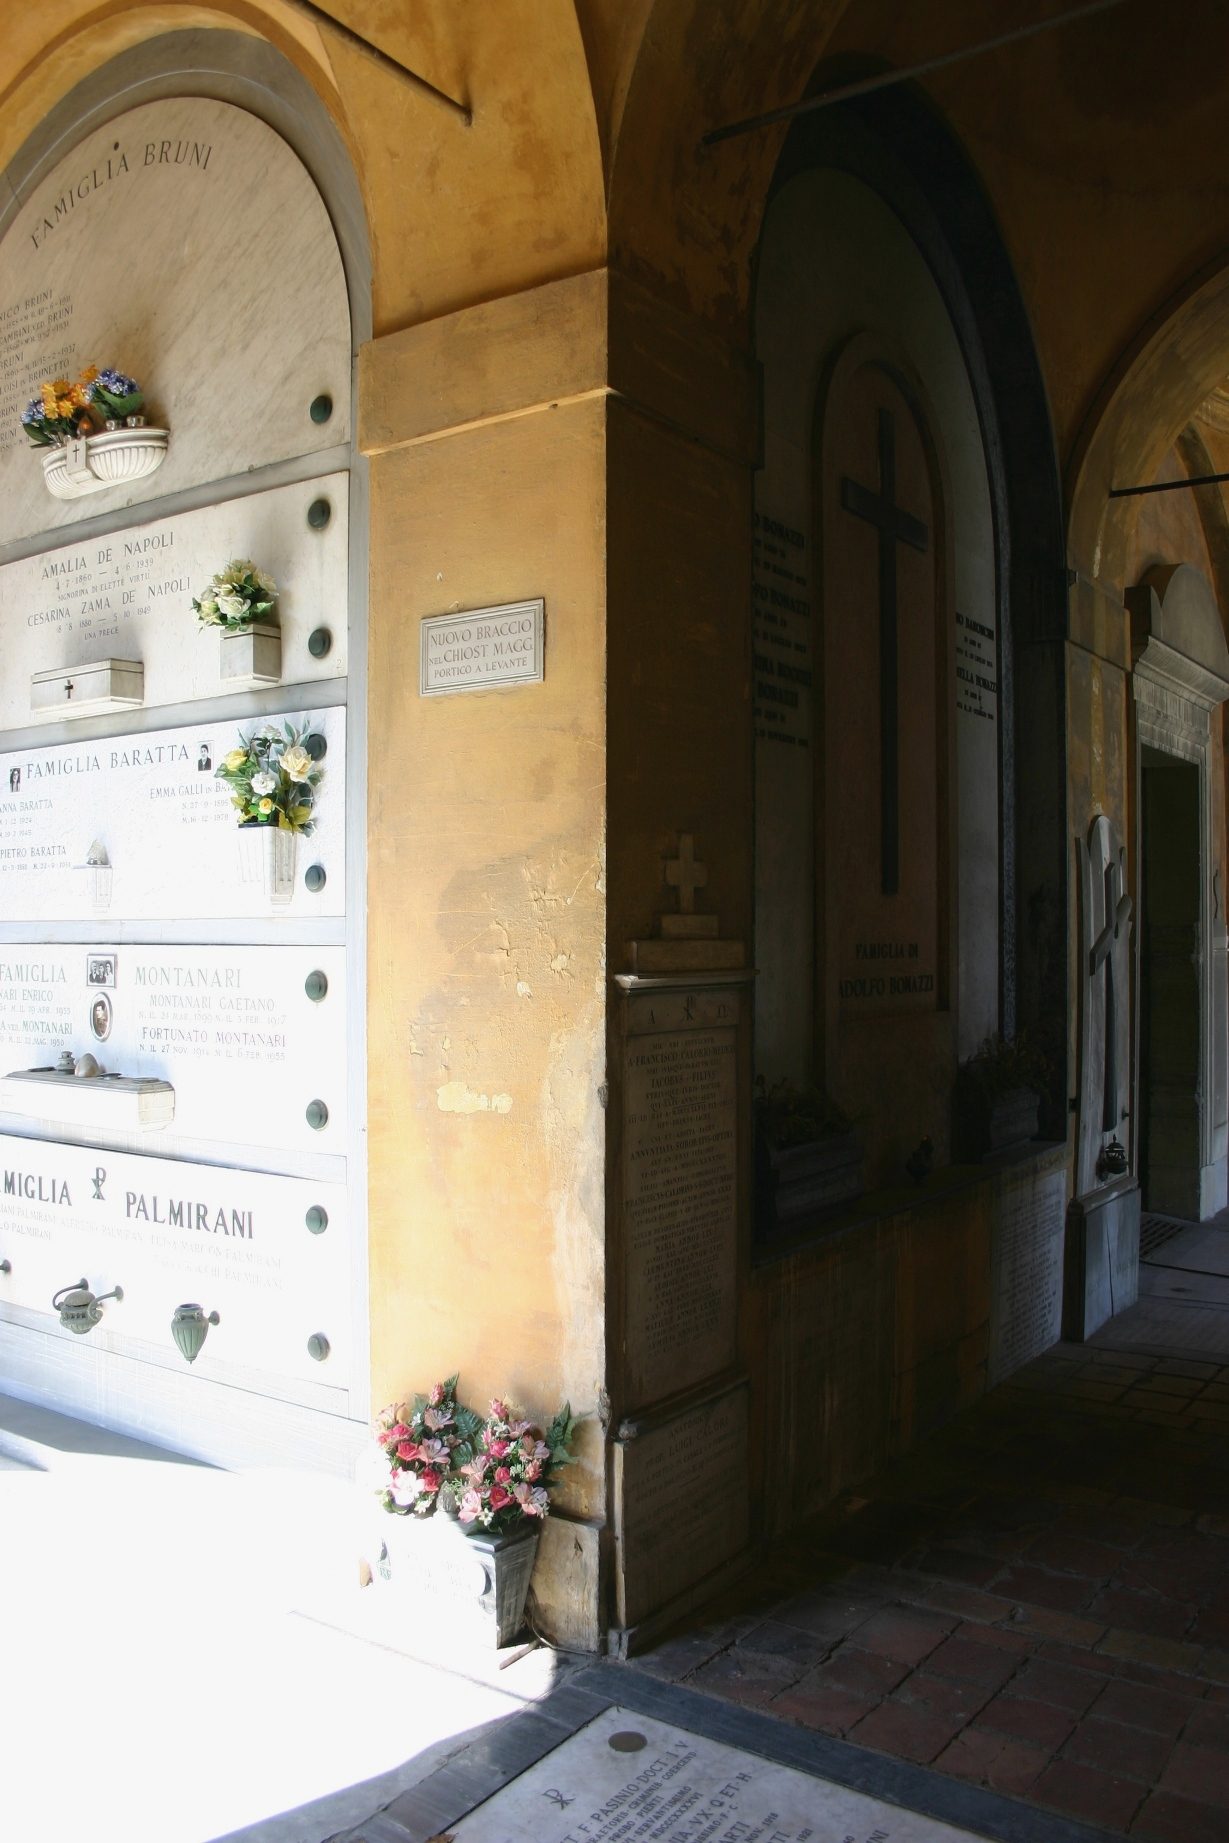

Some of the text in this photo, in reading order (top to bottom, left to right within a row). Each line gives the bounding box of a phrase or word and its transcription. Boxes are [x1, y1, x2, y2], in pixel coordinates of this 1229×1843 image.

[30, 140, 214, 250] FAMIGLIA BRUNI
[25, 288, 53, 310] BRUNI
[48, 304, 74, 325] BRUNI
[42, 531, 174, 581] AMALIA DE NAPOLI
[27, 576, 191, 628] CESARINA ZAMA DE NAPOLI
[431, 618, 533, 648] NUOVO BRACCIO
[428, 657, 443, 666] NEL
[434, 656, 528, 679] PORTICO A LEVANTE
[27, 744, 190, 779] FAMIGLIA BARATTA
[150, 787, 176, 799] EMMA
[178, 784, 203, 796] GALLI
[19, 799, 54, 812] BARATTA
[0, 844, 67, 859] PIETRO BARATTA
[0, 964, 241, 989] FAMIGLIA MONTANARI
[889, 974, 934, 996] BONAZZI
[22, 988, 54, 1002] ENRICO
[149, 994, 212, 1009] MONTANARI
[218, 996, 276, 1012] GAETANO
[22, 1020, 73, 1035] MONTANARI
[142, 1026, 286, 1048] FORTUNATO MONTANARI
[0, 1169, 254, 1240] MIGLIA PALMIRANI
[590, 1783, 640, 1823] PASINIO
[636, 1758, 669, 1784] DOCT
[719, 1782, 741, 1799] ET
[735, 1772, 753, 1784] H
[585, 1810, 630, 1843] RAETORIS
[608, 1794, 665, 1843] PROBO PIENTI
